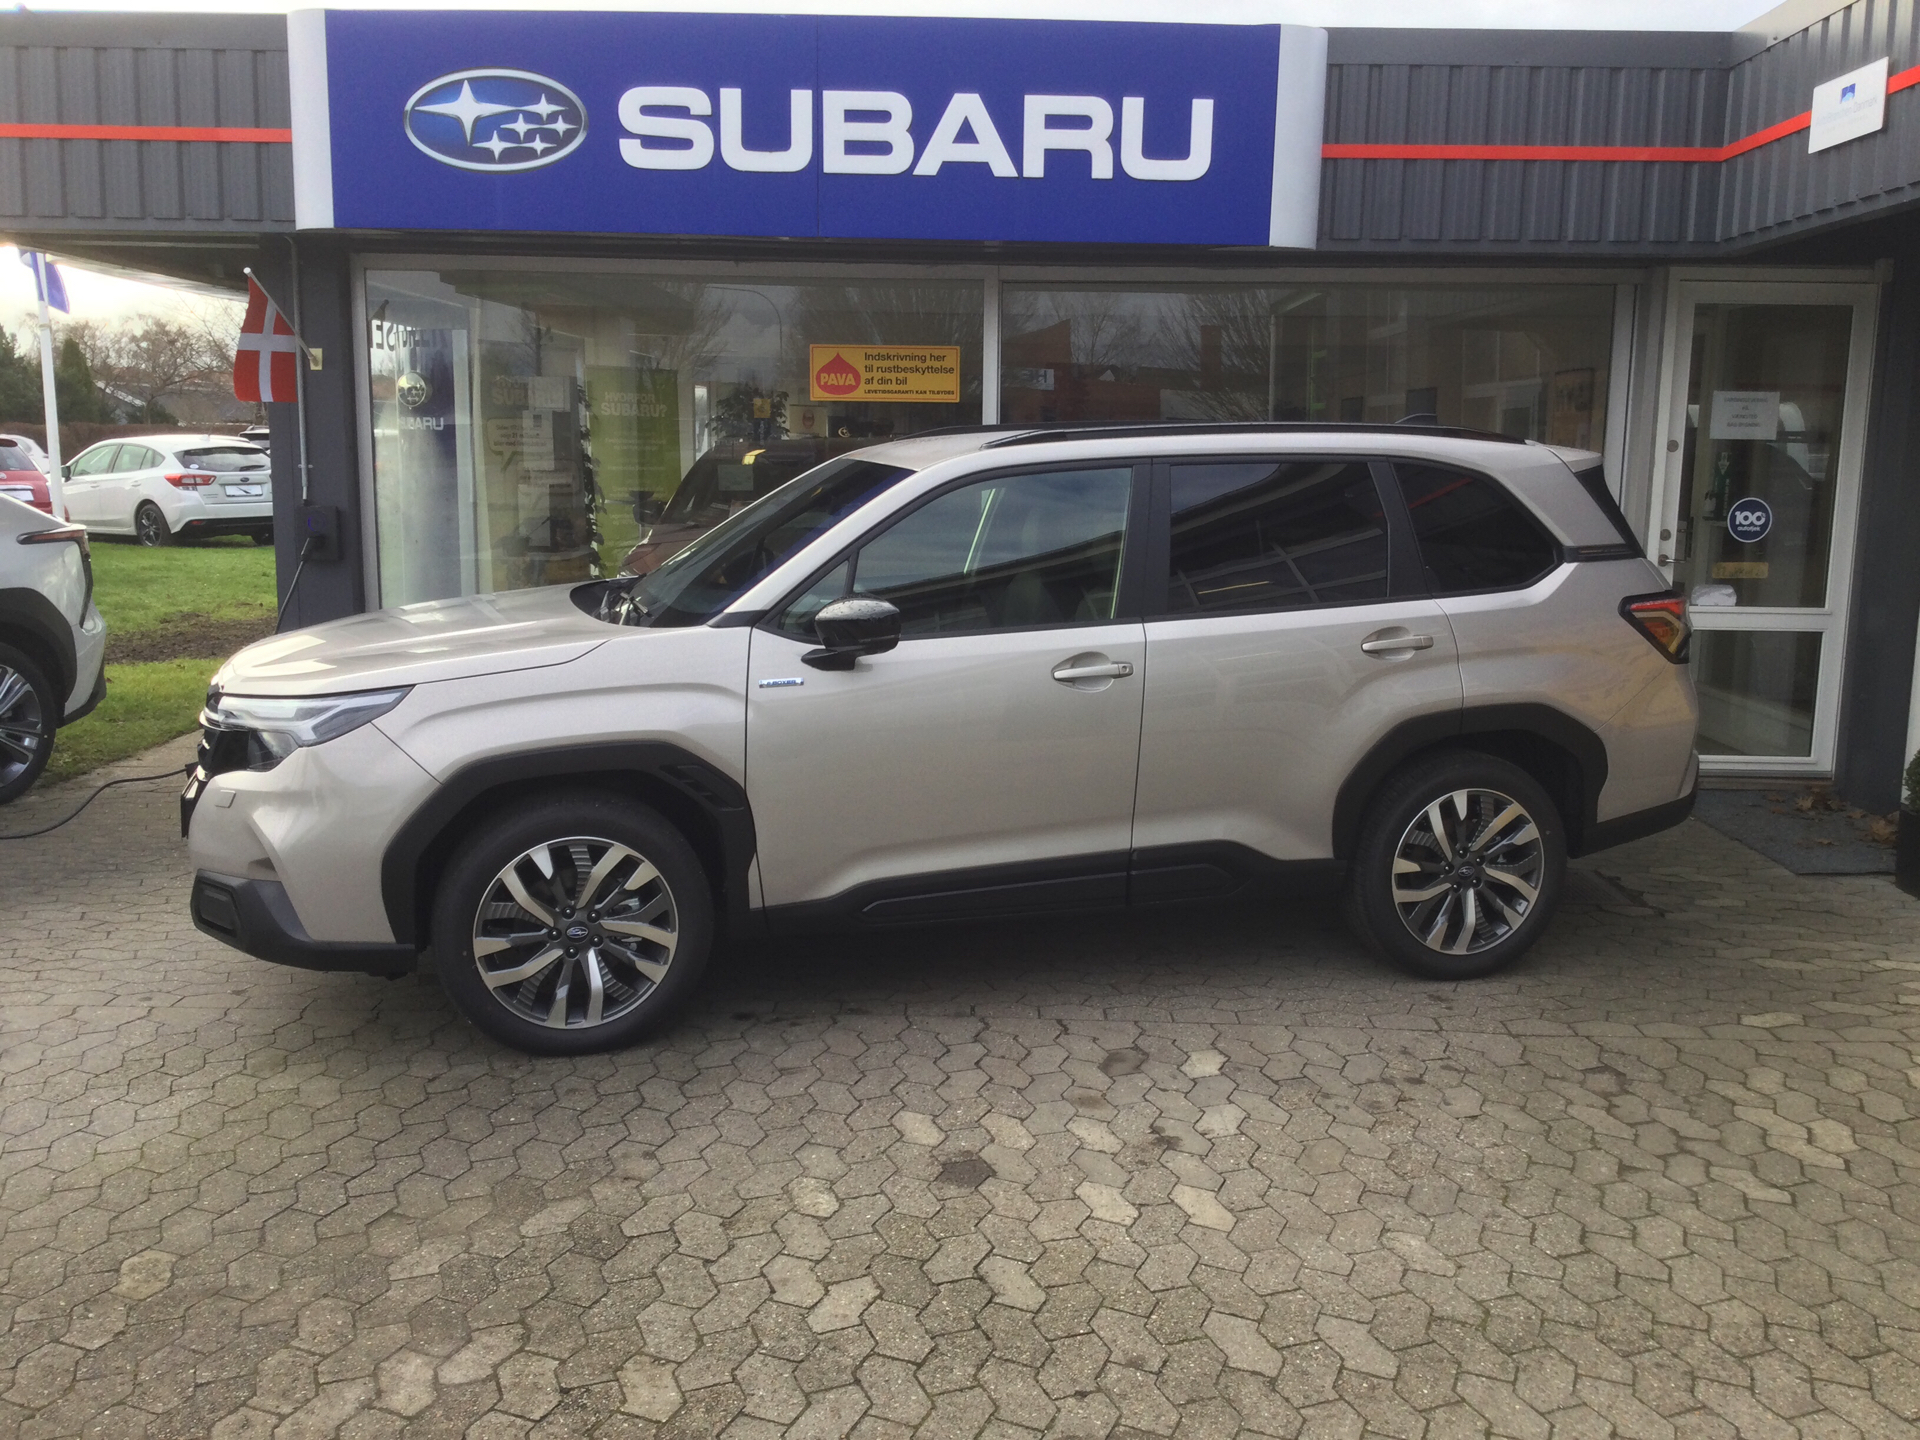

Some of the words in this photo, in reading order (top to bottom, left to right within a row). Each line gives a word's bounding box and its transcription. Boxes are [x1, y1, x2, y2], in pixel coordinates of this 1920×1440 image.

[617, 86, 1214, 182] SUBARU
[864, 352, 927, 364] Indskrivning
[929, 353, 947, 362] her
[864, 364, 874, 373] til
[876, 365, 955, 376] rustbeskyttelse
[820, 373, 856, 386] PAVA
[864, 376, 874, 385] af
[876, 376, 893, 386] din
[895, 376, 908, 386] bil
[604, 391, 656, 403] HVORFOR
[600, 402, 668, 417] SUBARU?
